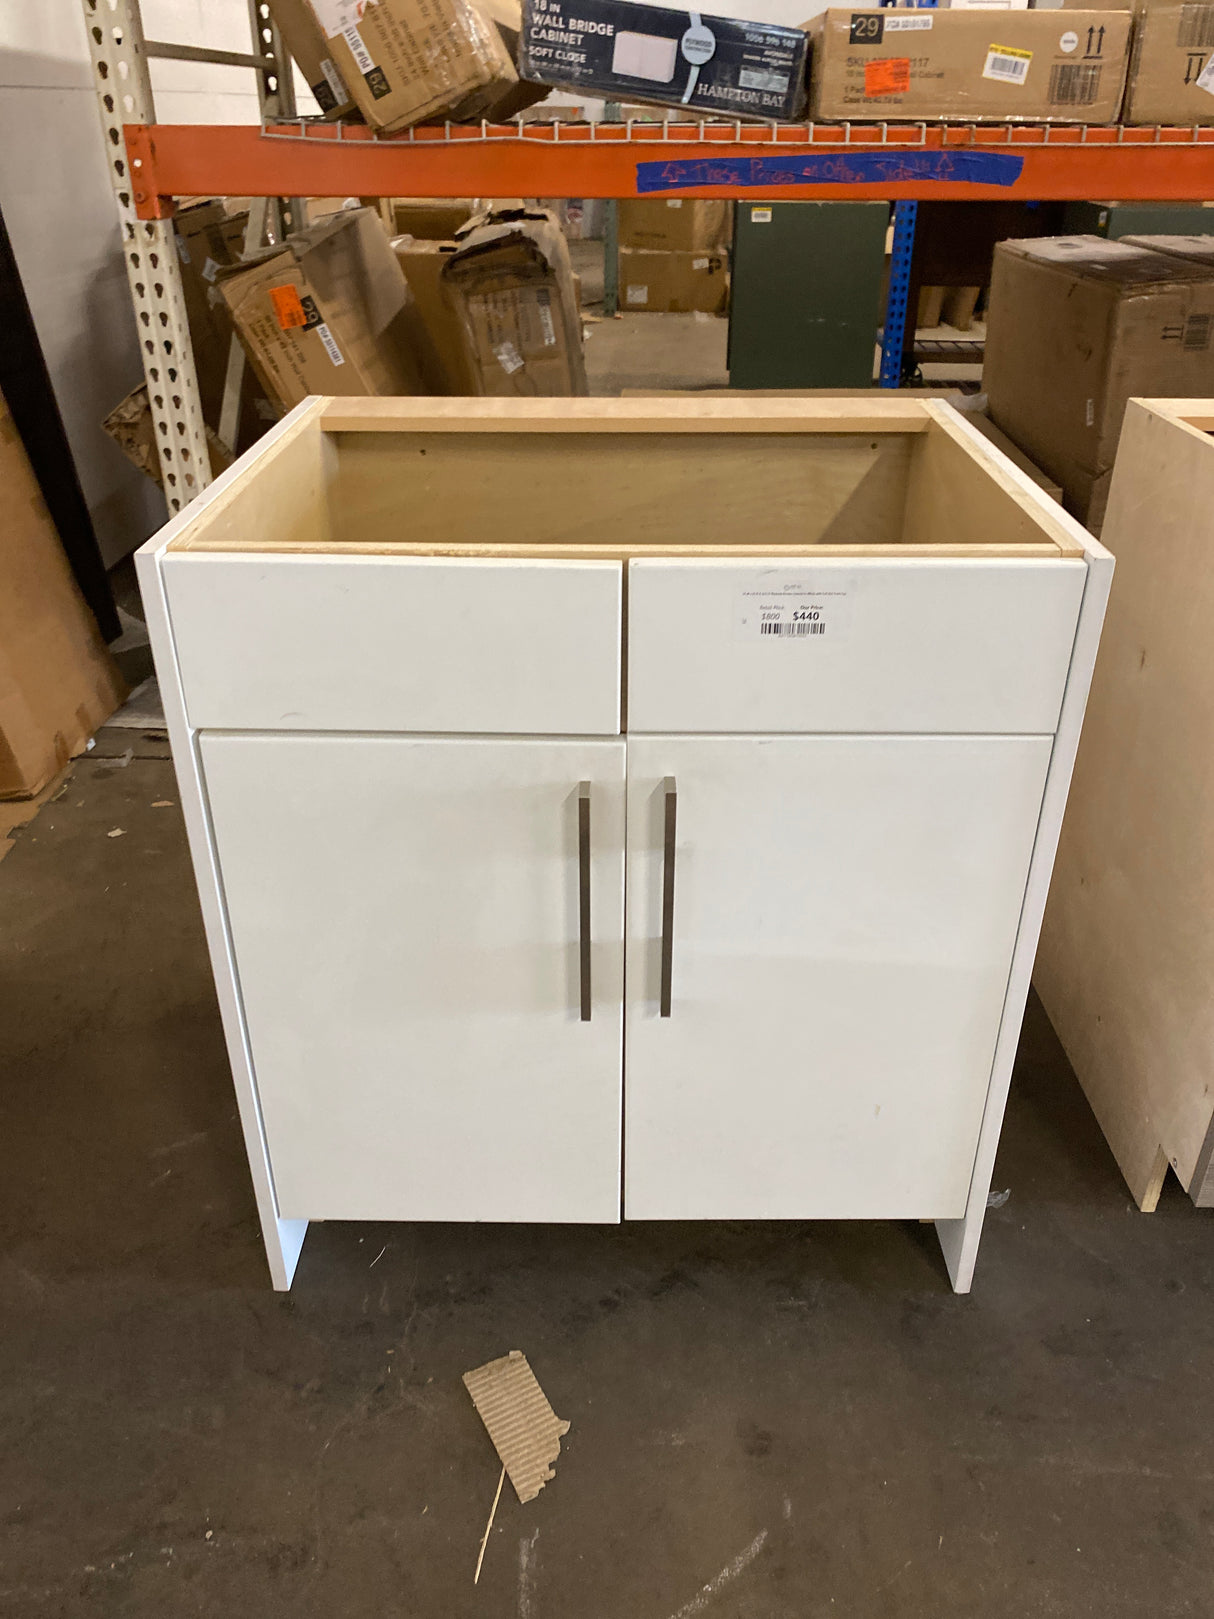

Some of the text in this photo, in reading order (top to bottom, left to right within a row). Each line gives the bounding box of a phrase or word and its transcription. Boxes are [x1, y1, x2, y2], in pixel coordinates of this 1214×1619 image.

[534, 0, 561, 13] 18 IN
[532, 12, 615, 37] WALL BRIDGE
[855, 17, 880, 37] 29
[530, 27, 585, 46] CABINET
[357, 51, 370, 69] PO#
[528, 45, 588, 64] SOFT CLOSE
[697, 83, 787, 108] HAMPTON BAY
[793, 611, 820, 621] $440
